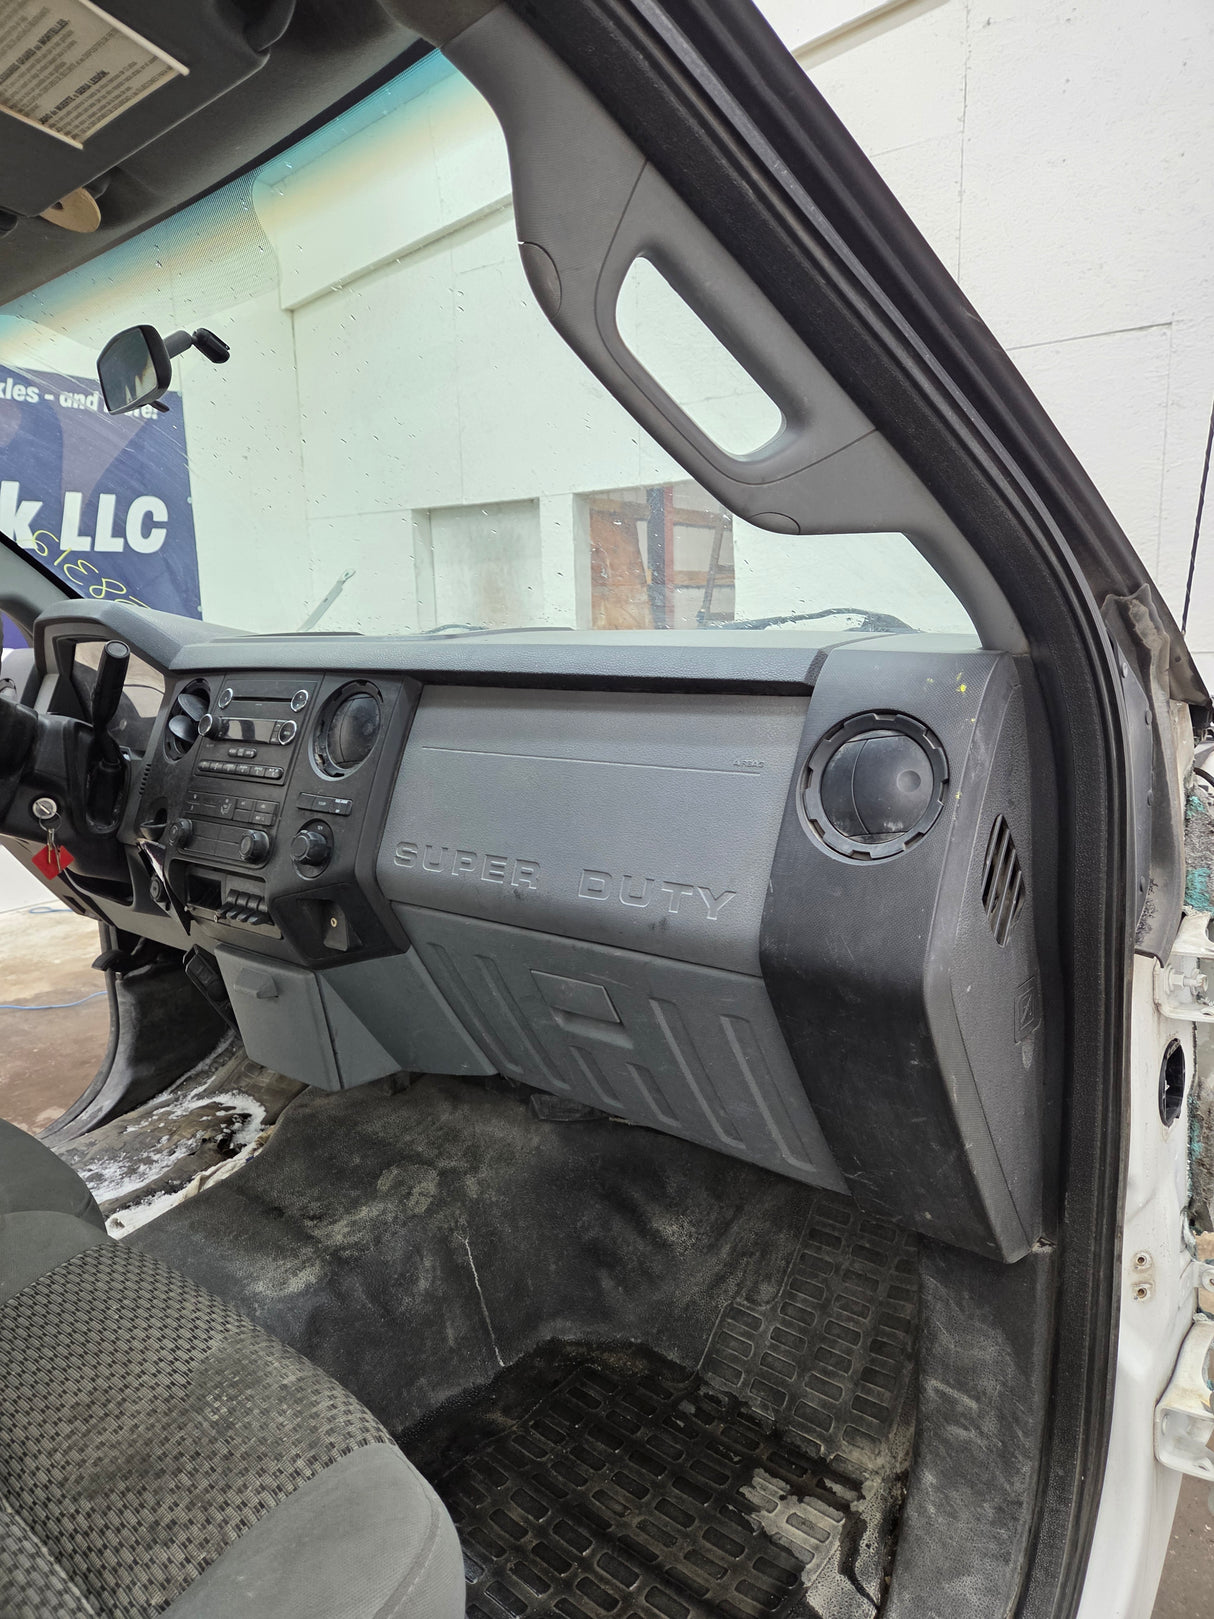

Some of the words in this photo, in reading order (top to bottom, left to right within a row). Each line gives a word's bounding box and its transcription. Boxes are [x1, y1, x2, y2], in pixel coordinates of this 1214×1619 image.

[59, 391, 99, 411] and
[60, 491, 169, 554] LLC
[393, 841, 541, 889] SUPER
[578, 868, 737, 921] DUTY
